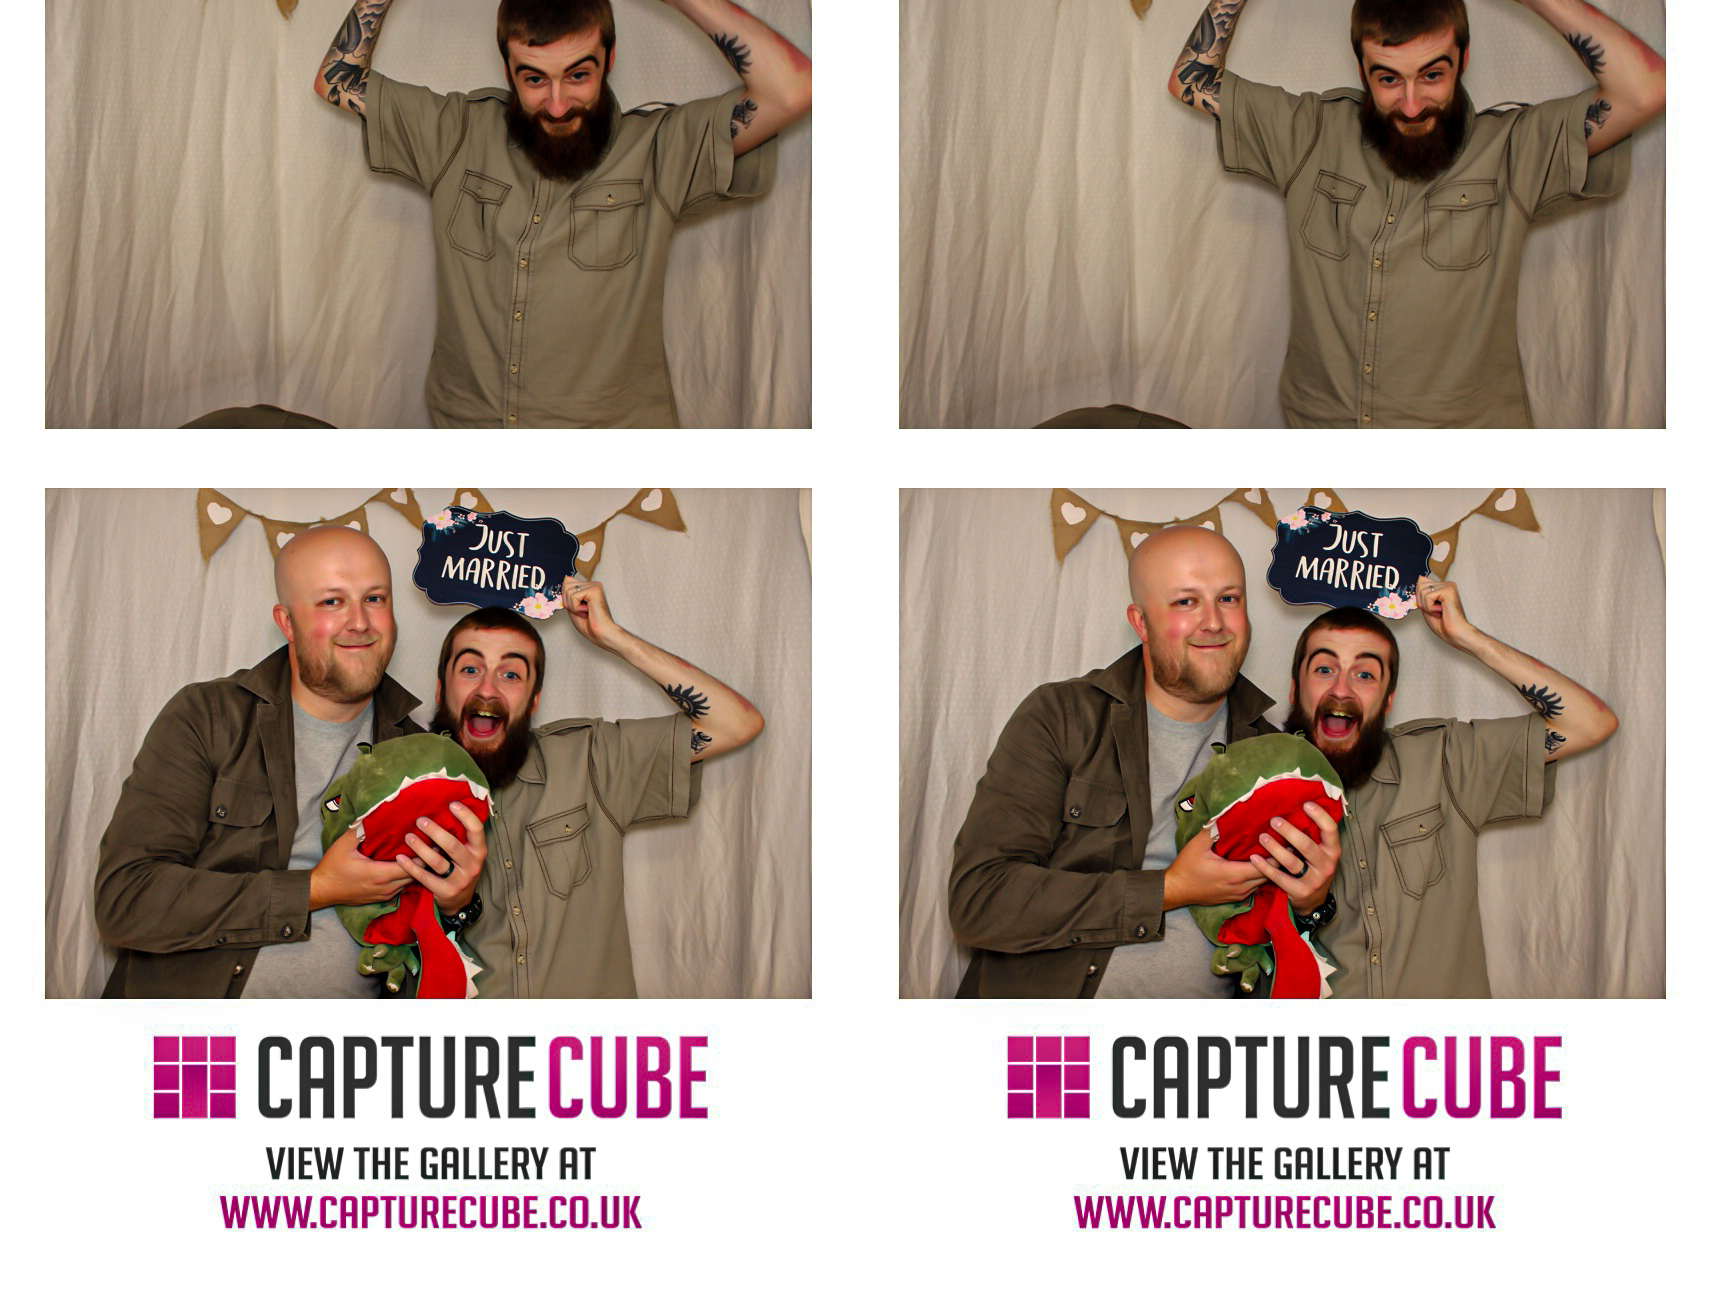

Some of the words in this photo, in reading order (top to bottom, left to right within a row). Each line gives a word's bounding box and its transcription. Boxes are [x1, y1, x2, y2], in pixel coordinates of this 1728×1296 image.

[468, 523, 530, 559] JUST
[1322, 523, 1384, 559] JUST
[440, 555, 546, 591] MARRIED
[1294, 555, 1400, 591] MARRIED
